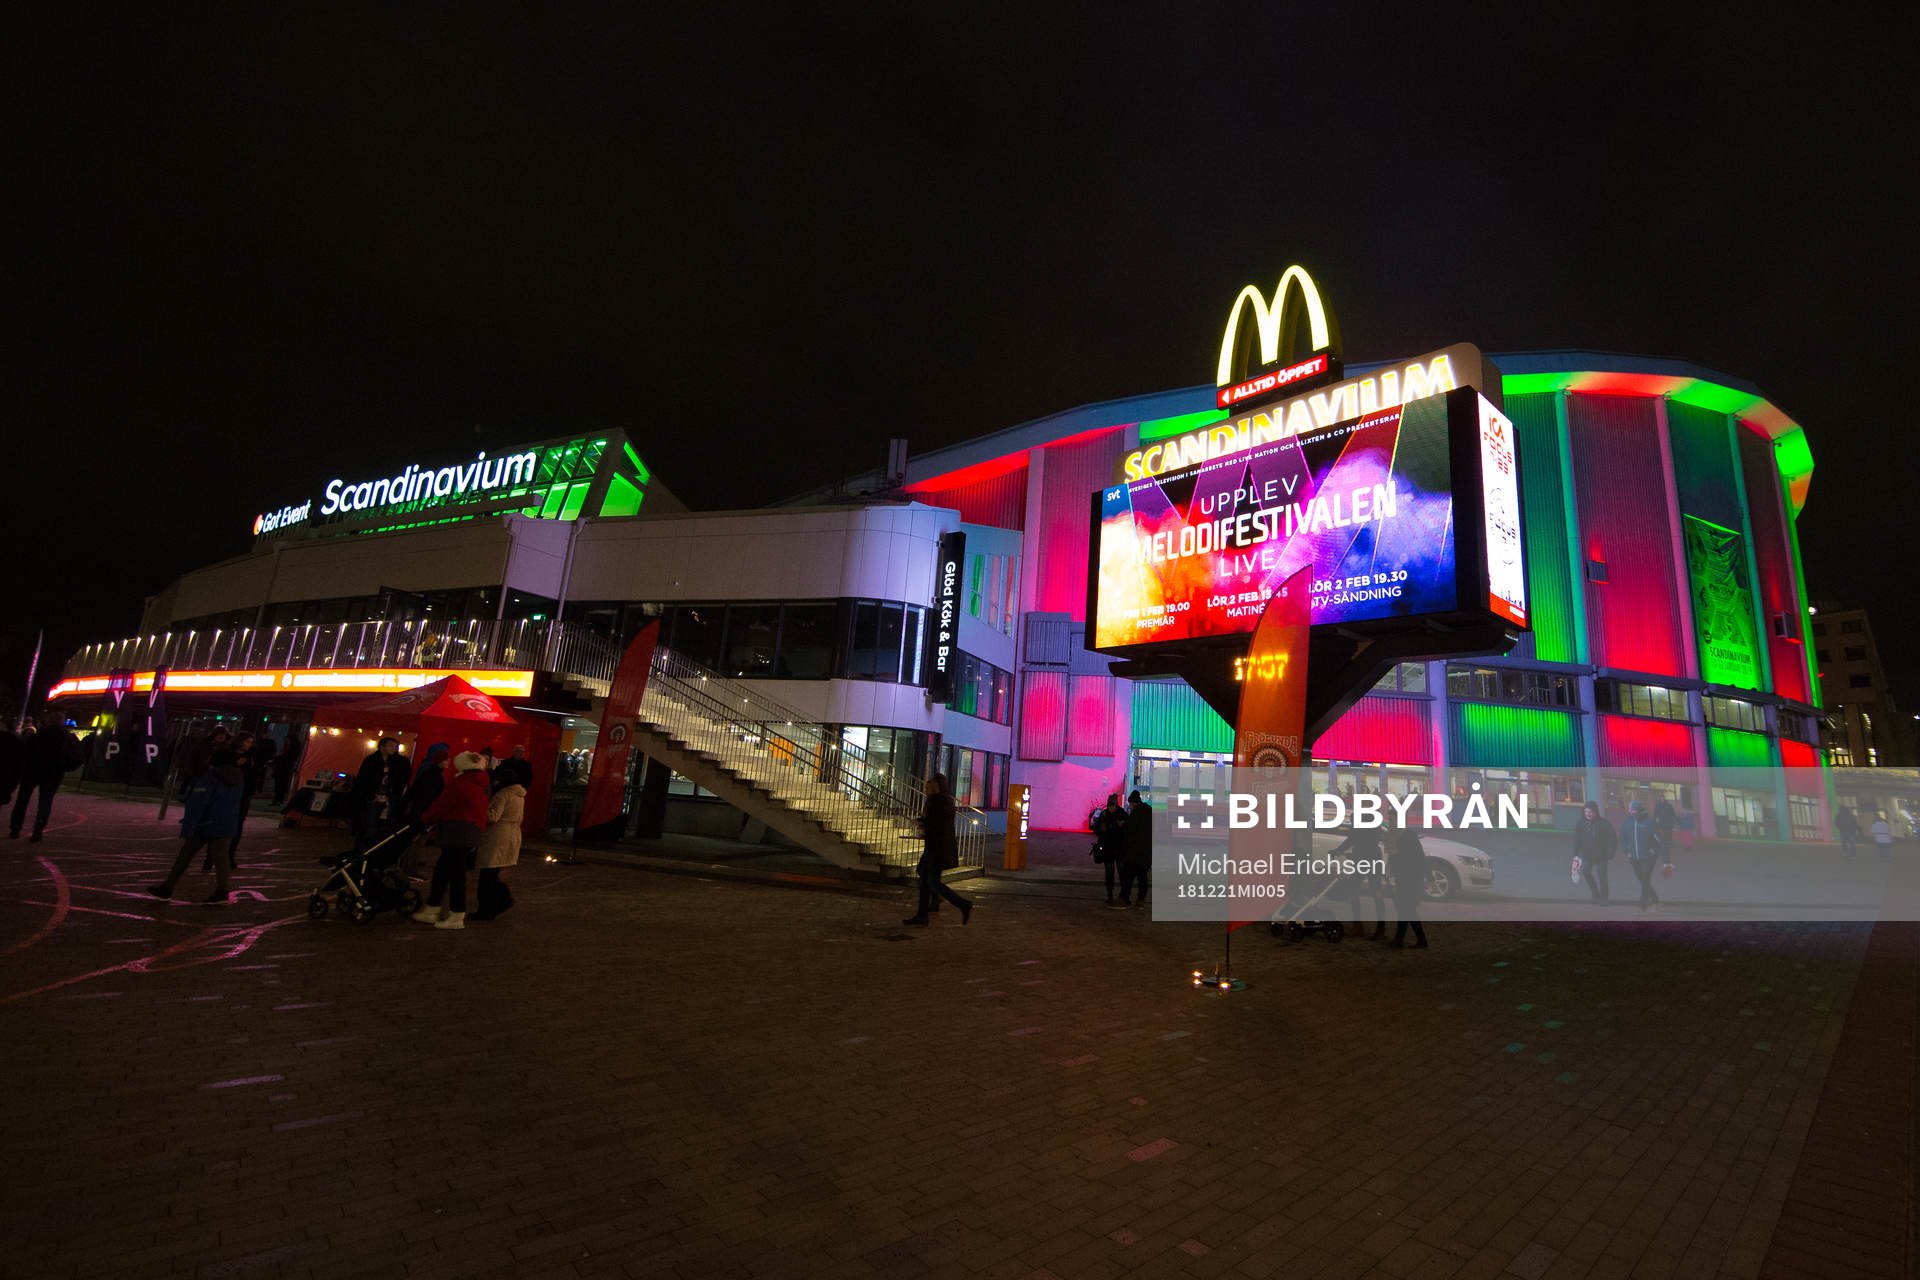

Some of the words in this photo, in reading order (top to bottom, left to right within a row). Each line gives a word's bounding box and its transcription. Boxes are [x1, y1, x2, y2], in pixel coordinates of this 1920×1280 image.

[1234, 376, 1275, 400] ALLTID
[1278, 359, 1322, 383] ÖPPET
[1124, 355, 1456, 483] SCANDINAVIUM
[1154, 474, 1185, 487] TELEVISION
[1225, 459, 1238, 467] MED
[1239, 455, 1252, 463] LIVE
[1255, 448, 1279, 459] NATION
[1281, 443, 1294, 451] OCH
[1297, 434, 1325, 447] BLIXTEN
[1347, 413, 1400, 432] PRESENTERAR
[321, 451, 537, 515] Scandinavium
[1106, 490, 1121, 502] svt
[1201, 476, 1298, 515] UPPLEV
[262, 508, 282, 533] Got
[281, 500, 311, 527] Event
[1132, 481, 1397, 566] MELODIFESTIVALEN
[1220, 549, 1277, 577] LIVE
[944, 561, 956, 596] Glöd
[1309, 580, 1332, 594] LÖR
[1335, 580, 1342, 590] 2
[1346, 575, 1371, 588] FEB
[1373, 570, 1407, 585] 19.30
[1166, 602, 1190, 613] 19.00
[1208, 595, 1228, 608] LÖR
[1229, 594, 1236, 605] 2
[1238, 591, 1259, 604] FEB
[1313, 586, 1401, 607] TV-SÄNDNING
[941, 599, 952, 628] Kök
[1136, 616, 1175, 629] PREMIÄR
[939, 632, 950, 642] &
[937, 646, 949, 672] Bar
[145, 688, 160, 763] VIP
